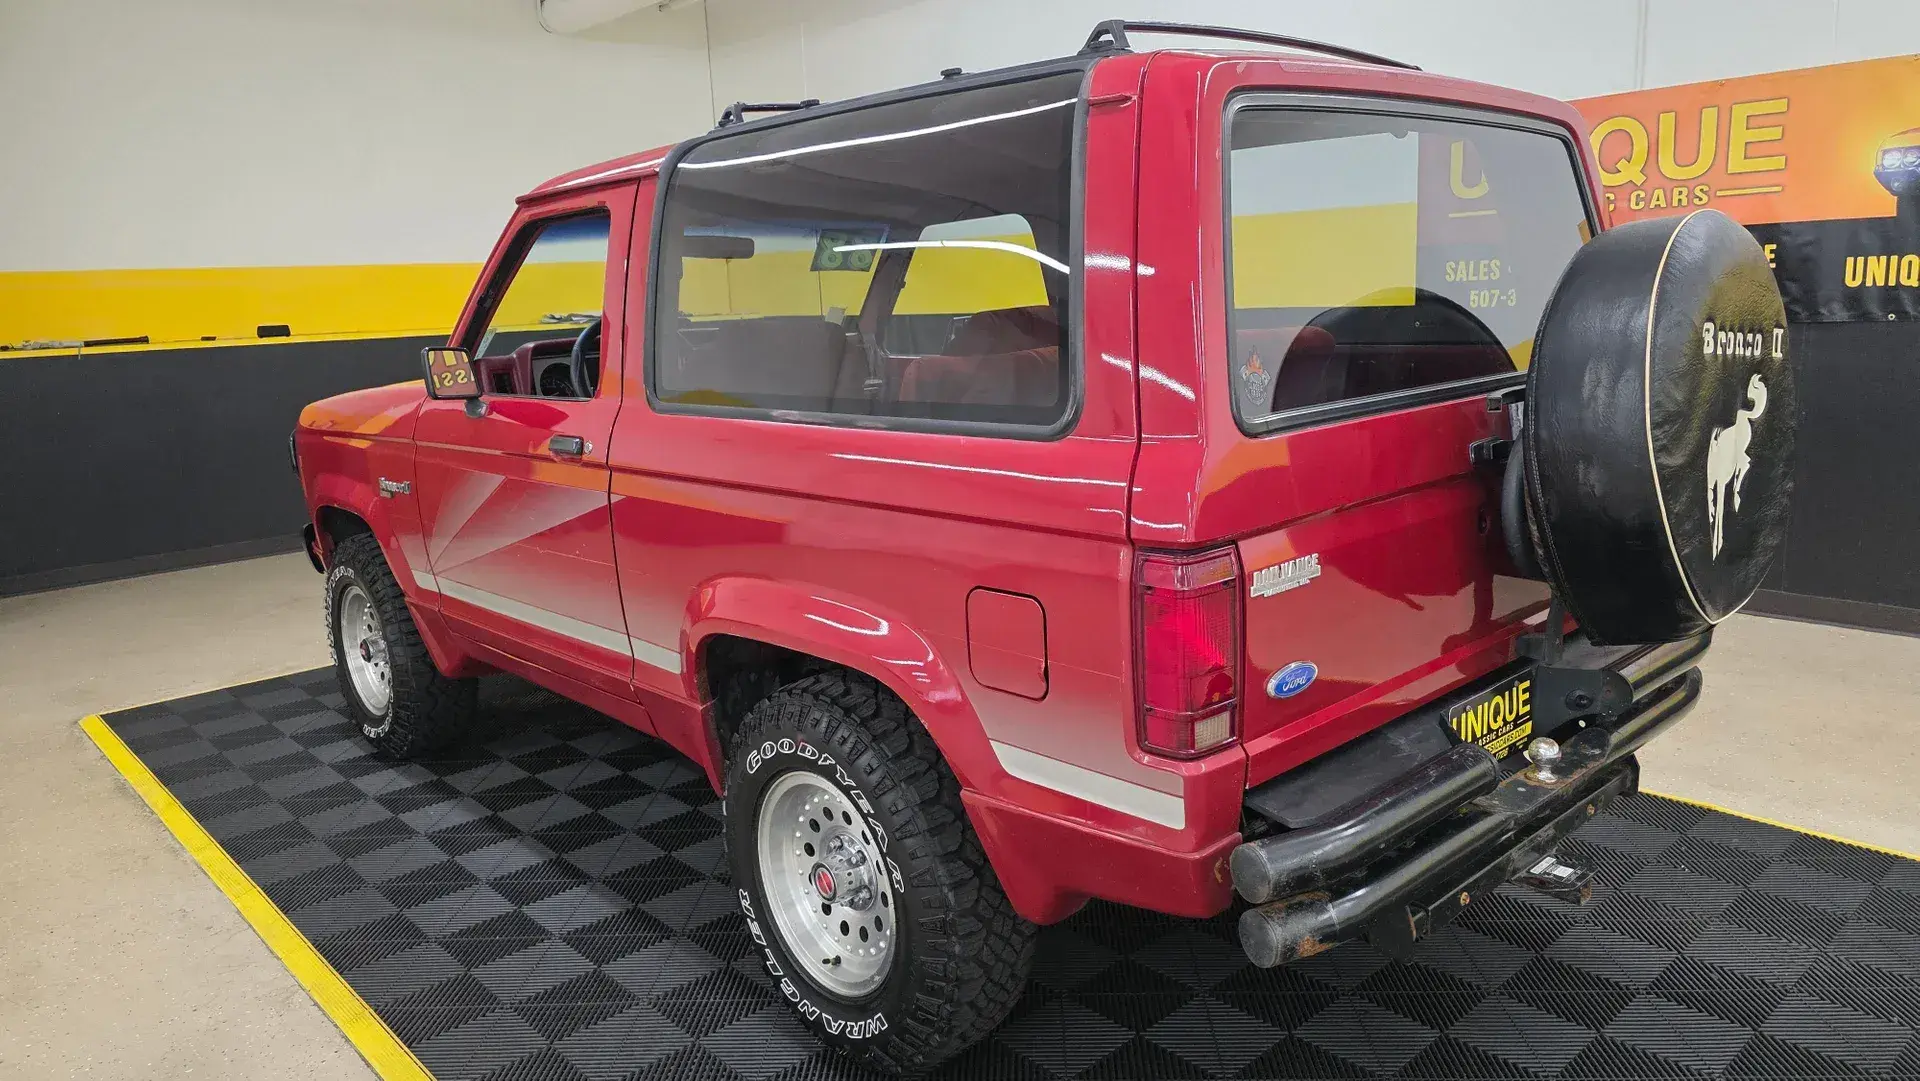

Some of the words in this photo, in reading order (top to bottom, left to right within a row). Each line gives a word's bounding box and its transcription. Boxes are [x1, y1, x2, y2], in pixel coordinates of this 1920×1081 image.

[1590, 98, 1788, 187] QUE
[1630, 185, 1710, 211] CARS
[1445, 259, 1501, 283] SALES
[1844, 254, 1920, 288] UNIQ
[1469, 288, 1517, 309] 507-3
[1702, 321, 1763, 356] Bronco
[1282, 670, 1310, 692] Ford
[1498, 721, 1514, 737] CARS
[746, 738, 905, 893] GOODYEAR
[738, 889, 889, 1039] WRANGLER
